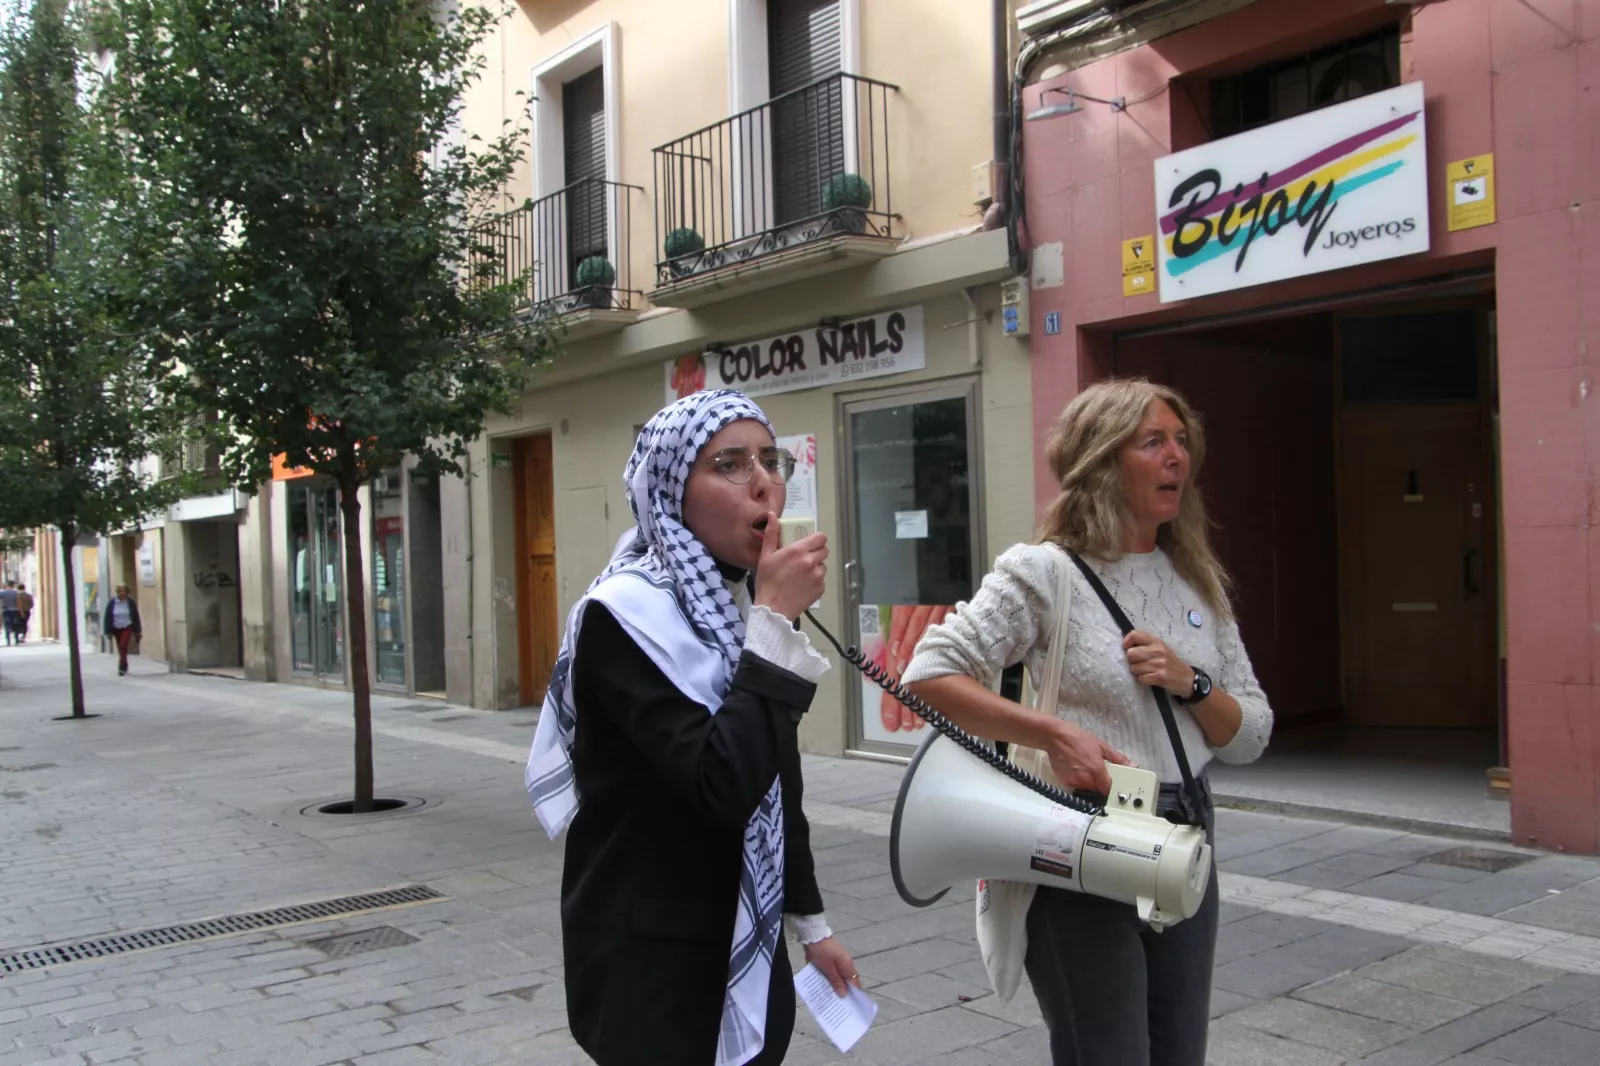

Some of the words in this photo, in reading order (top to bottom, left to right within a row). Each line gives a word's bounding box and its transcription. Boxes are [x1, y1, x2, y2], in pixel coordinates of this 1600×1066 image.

[1168, 168, 1338, 273] Bijoy
[1322, 217, 1416, 251] Joyeros
[719, 335, 806, 385] COLOR
[815, 312, 906, 366] NAILS
[1046, 312, 1059, 333] 61
